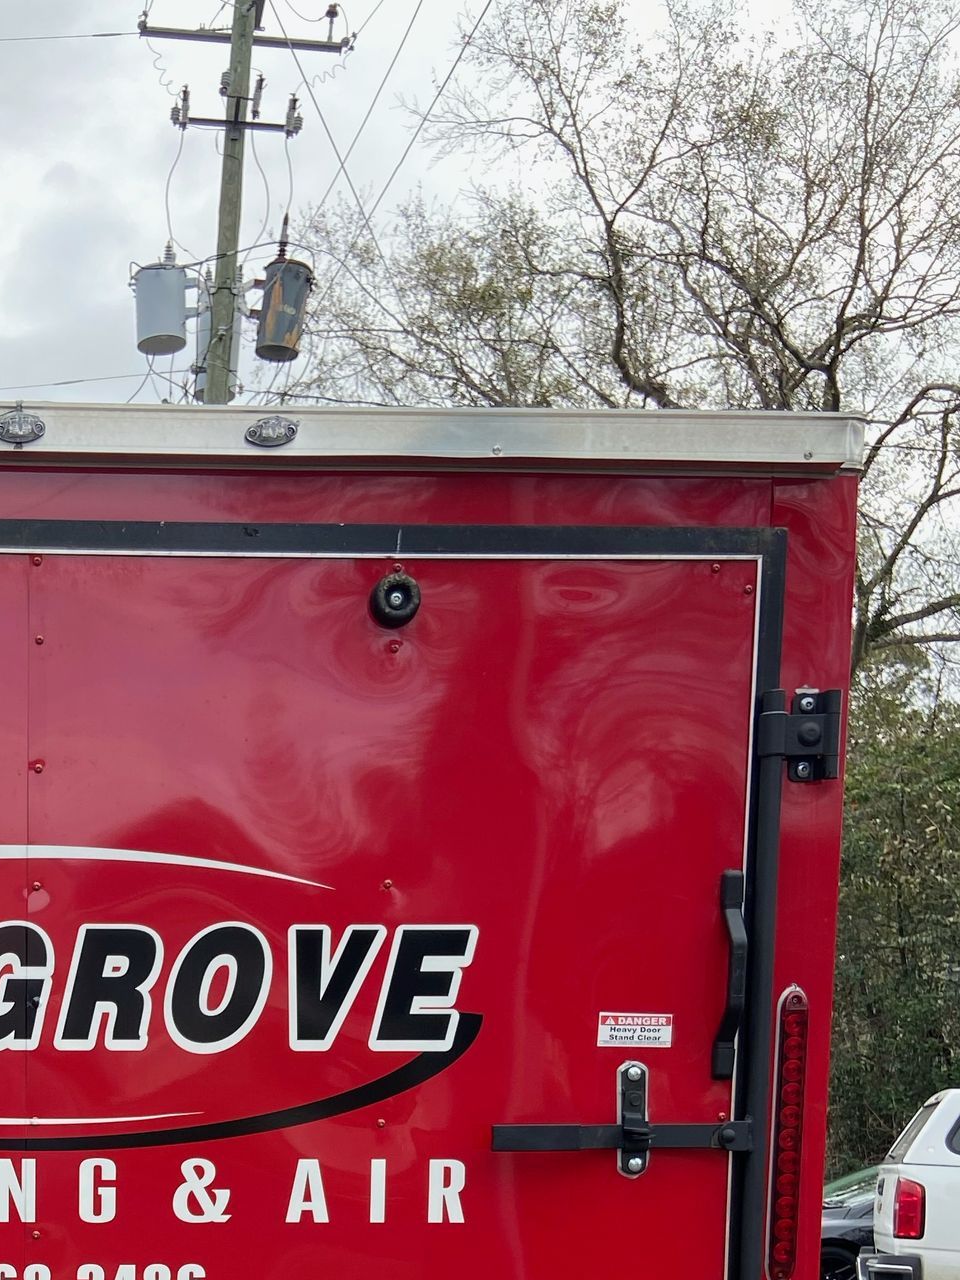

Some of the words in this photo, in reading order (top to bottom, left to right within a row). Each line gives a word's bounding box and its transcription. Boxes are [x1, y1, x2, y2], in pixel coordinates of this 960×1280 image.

[618, 1017, 666, 1025] DANGER
[172, 1157, 232, 1224] &
[285, 1157, 466, 1224] AIR
